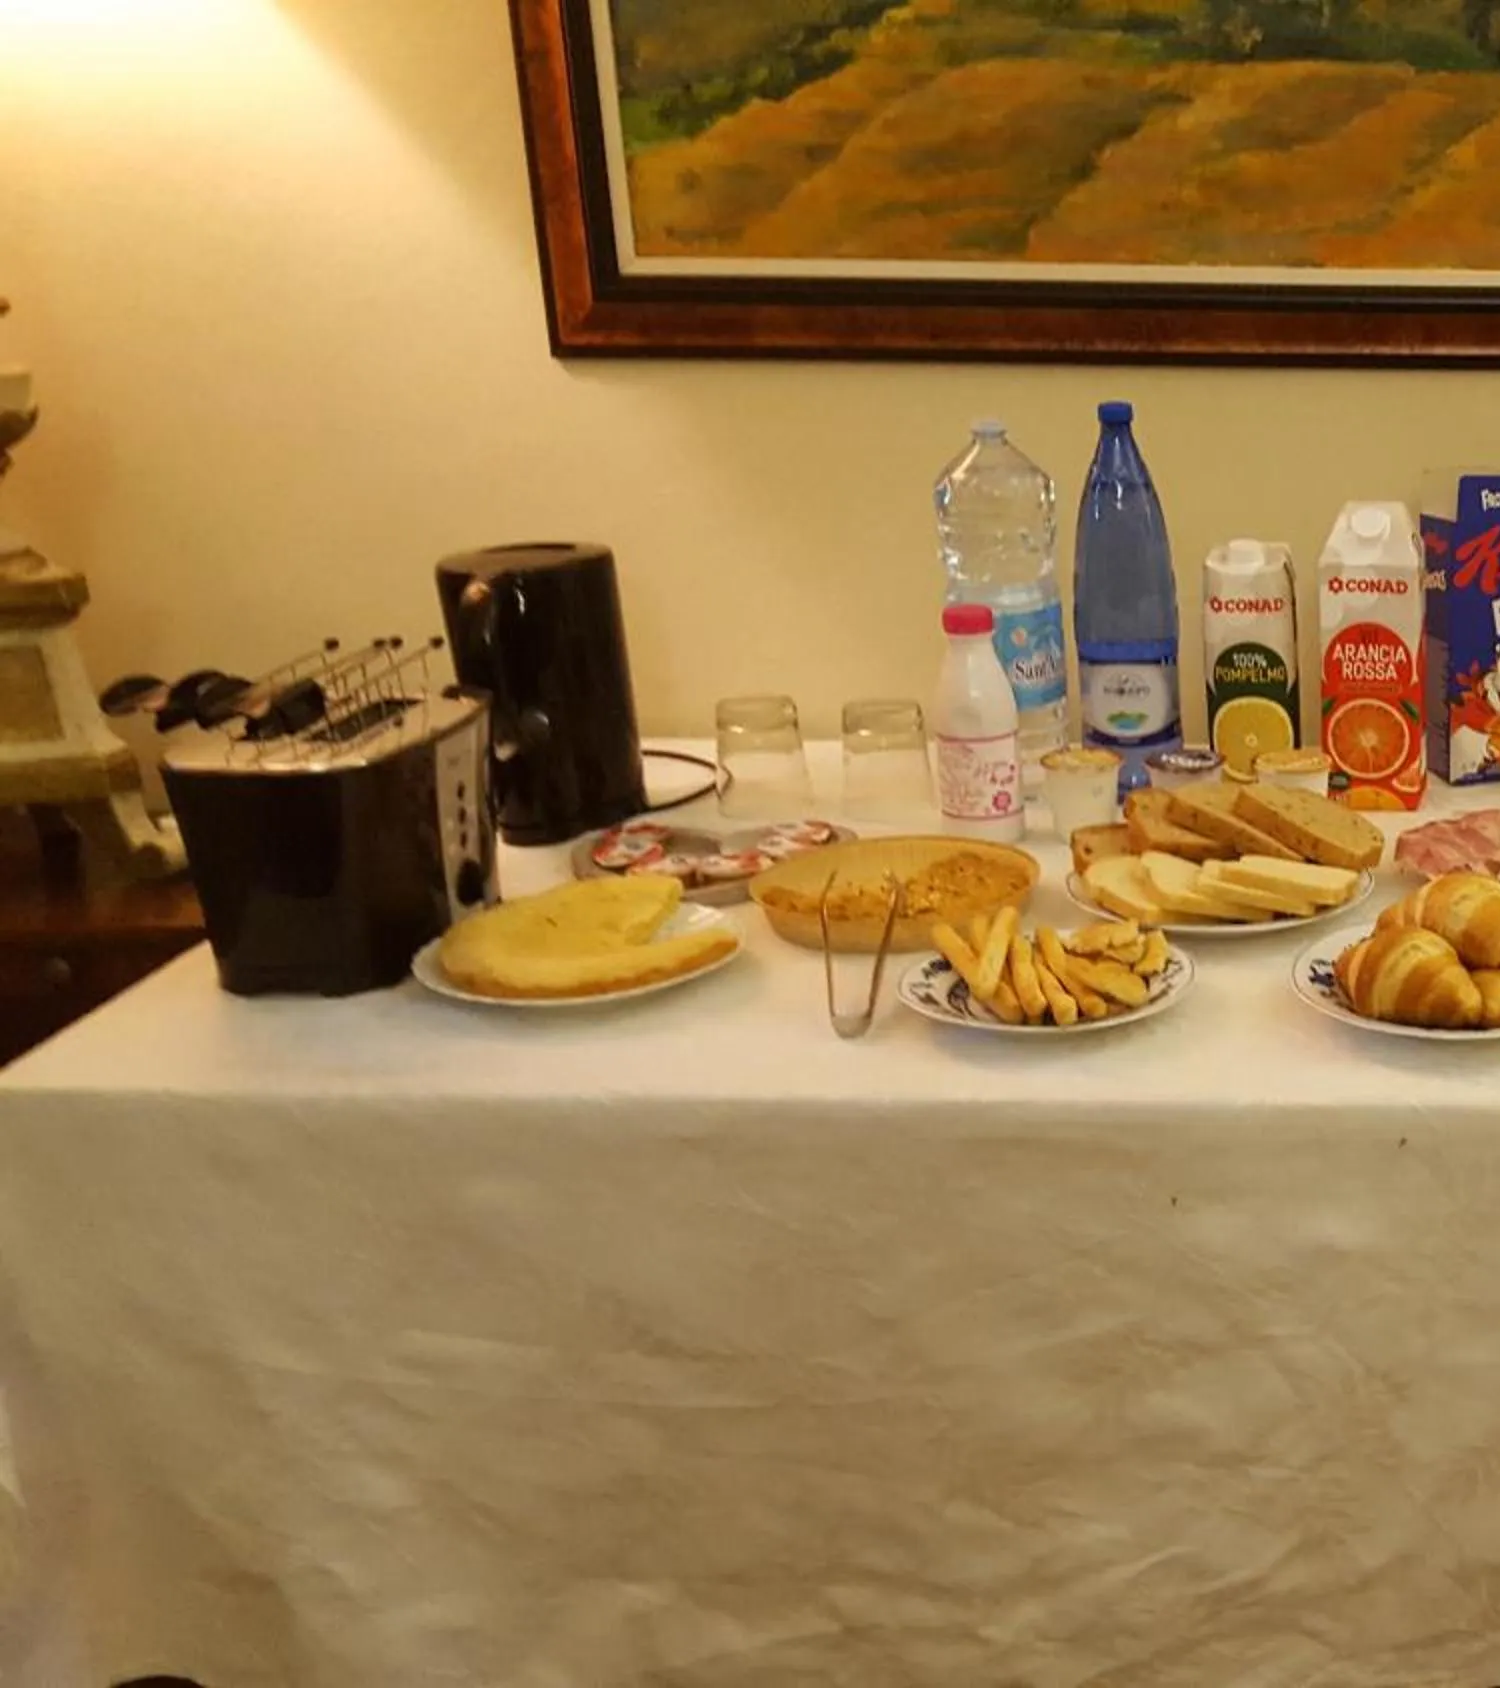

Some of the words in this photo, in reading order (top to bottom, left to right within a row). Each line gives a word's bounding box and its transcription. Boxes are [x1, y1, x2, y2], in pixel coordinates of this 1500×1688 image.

[1345, 578, 1408, 595] CONAD
[1225, 597, 1284, 612] CONAD
[1232, 652, 1268, 669] 100%
[1332, 643, 1407, 664] ARANCIA
[1215, 665, 1285, 683] POMPELMO
[1342, 660, 1397, 681] ROSSA
